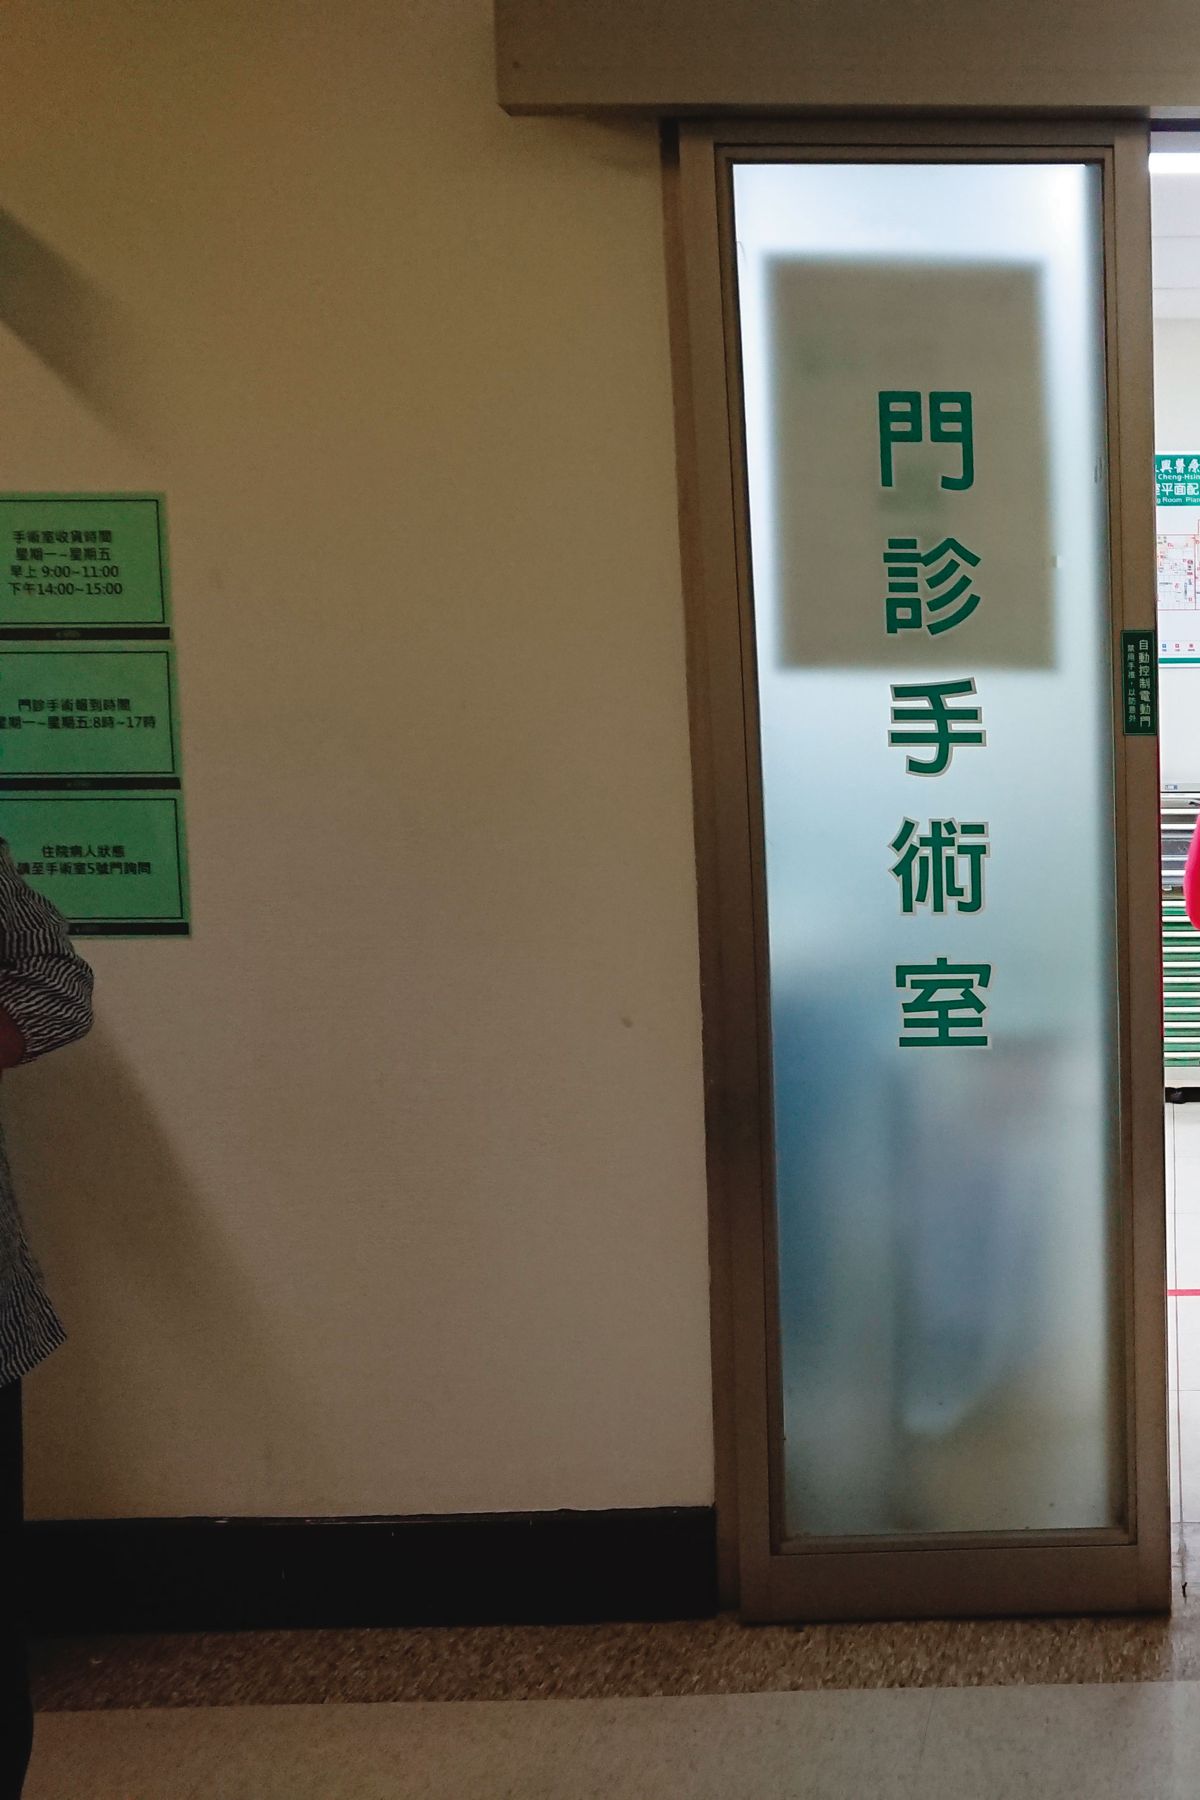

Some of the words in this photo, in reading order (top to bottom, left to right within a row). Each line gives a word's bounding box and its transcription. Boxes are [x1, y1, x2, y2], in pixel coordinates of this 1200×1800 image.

[1158, 473, 1200, 481] Cheng-Hsin
[10, 565, 37, 578] 早上
[1138, 639, 1151, 728] 自動控制電動門
[877, 390, 992, 1048] 門診手術室
